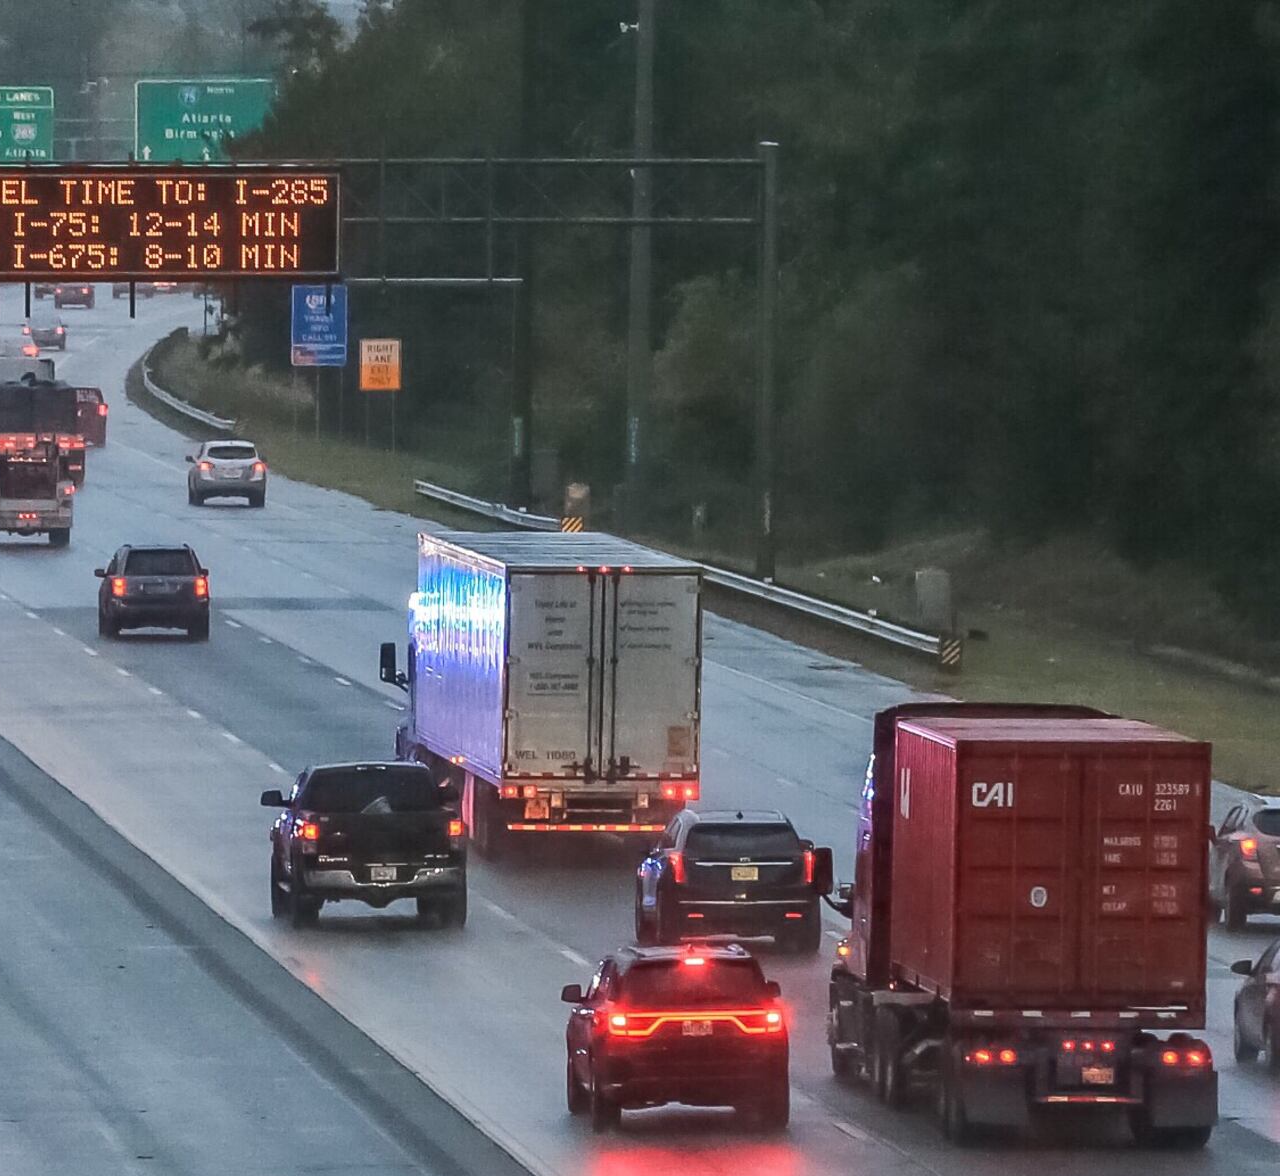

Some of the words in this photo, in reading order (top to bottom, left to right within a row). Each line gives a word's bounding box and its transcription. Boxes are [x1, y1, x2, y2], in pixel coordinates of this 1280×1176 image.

[6, 92, 40, 102] LANES
[60, 179, 135, 204] TIME
[156, 179, 205, 204] TO:
[236, 179, 328, 204] I-285
[14, 211, 100, 237] I-75:
[128, 211, 221, 237] 12-14
[241, 211, 300, 237] MIN
[14, 243, 118, 269] I-675:
[145, 243, 221, 269] 8-10
[241, 243, 300, 269] MIN
[367, 344, 393, 353] RIGHT
[368, 355, 392, 363] LANE
[515, 750, 538, 760] WEL
[972, 782, 1014, 808] CAI
[1118, 783, 1143, 796] CAIU
